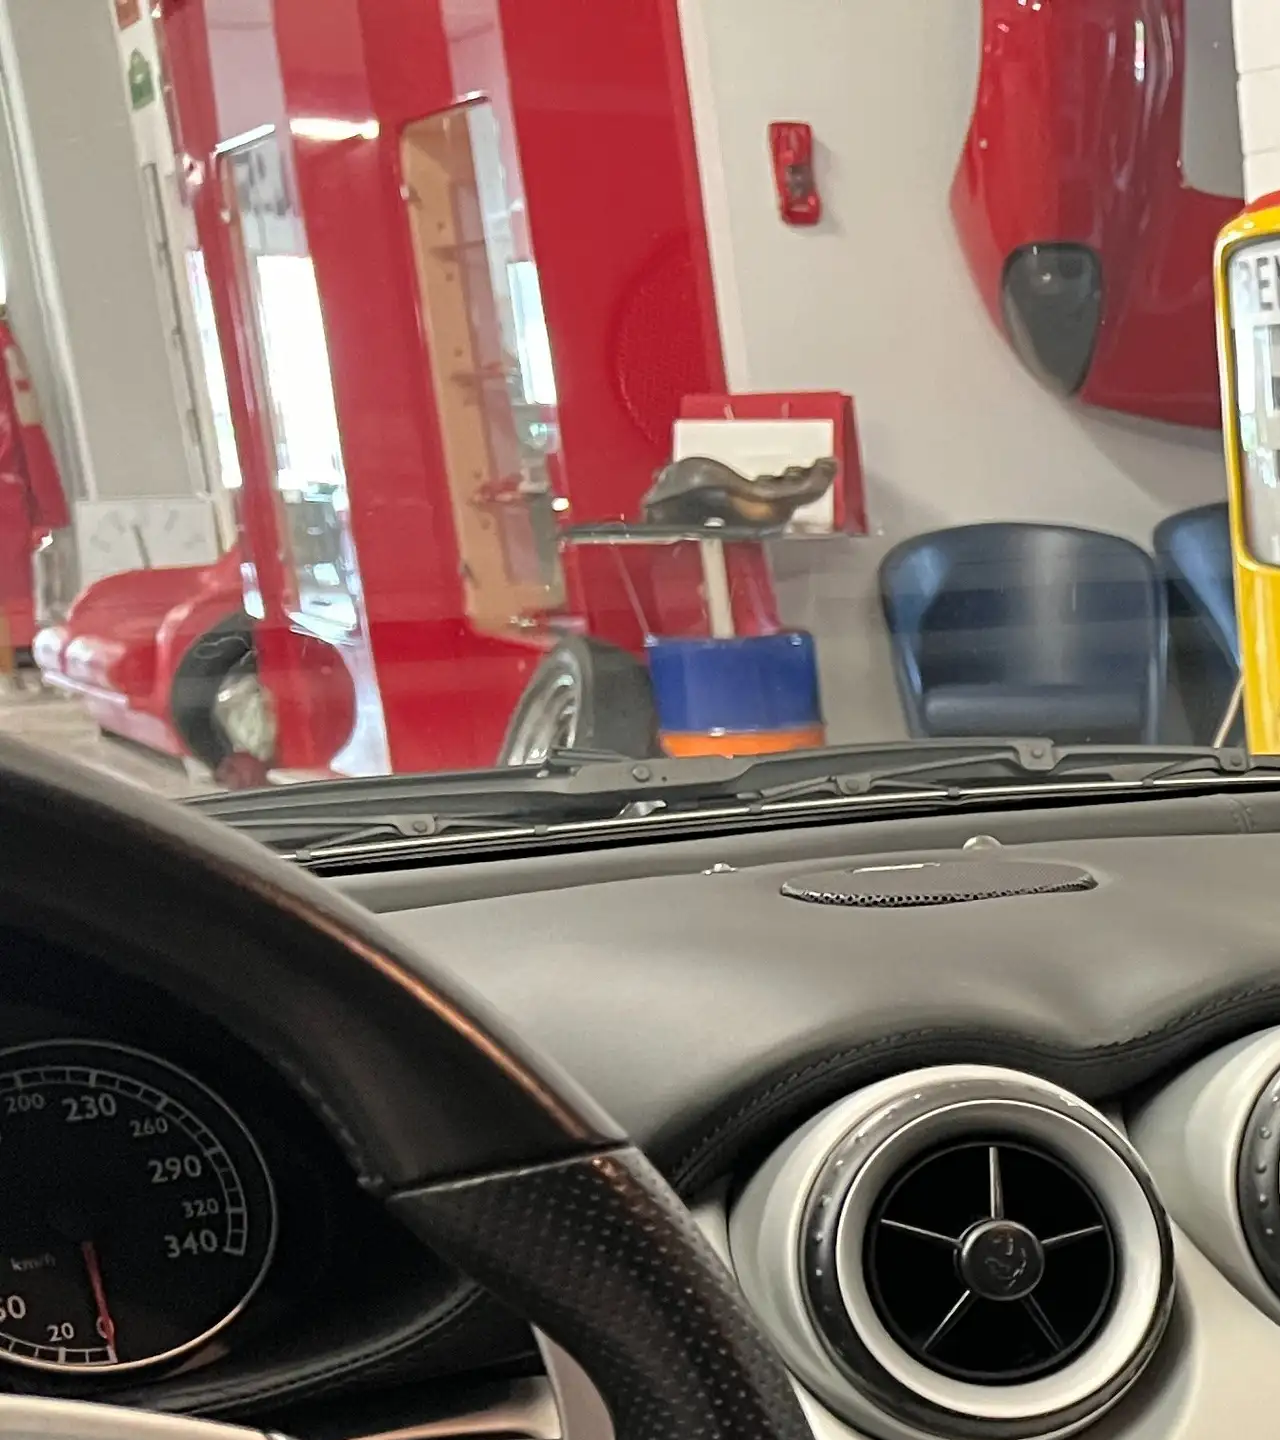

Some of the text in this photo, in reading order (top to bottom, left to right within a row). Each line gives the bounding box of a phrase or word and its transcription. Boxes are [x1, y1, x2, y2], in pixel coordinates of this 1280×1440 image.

[6, 1093, 46, 1115] 200
[62, 1093, 117, 1122] 230
[129, 1117, 169, 1138] 260
[149, 1155, 202, 1184] 290
[181, 1198, 220, 1219] 320
[164, 1229, 218, 1258] 340
[46, 1322, 75, 1342] 20
